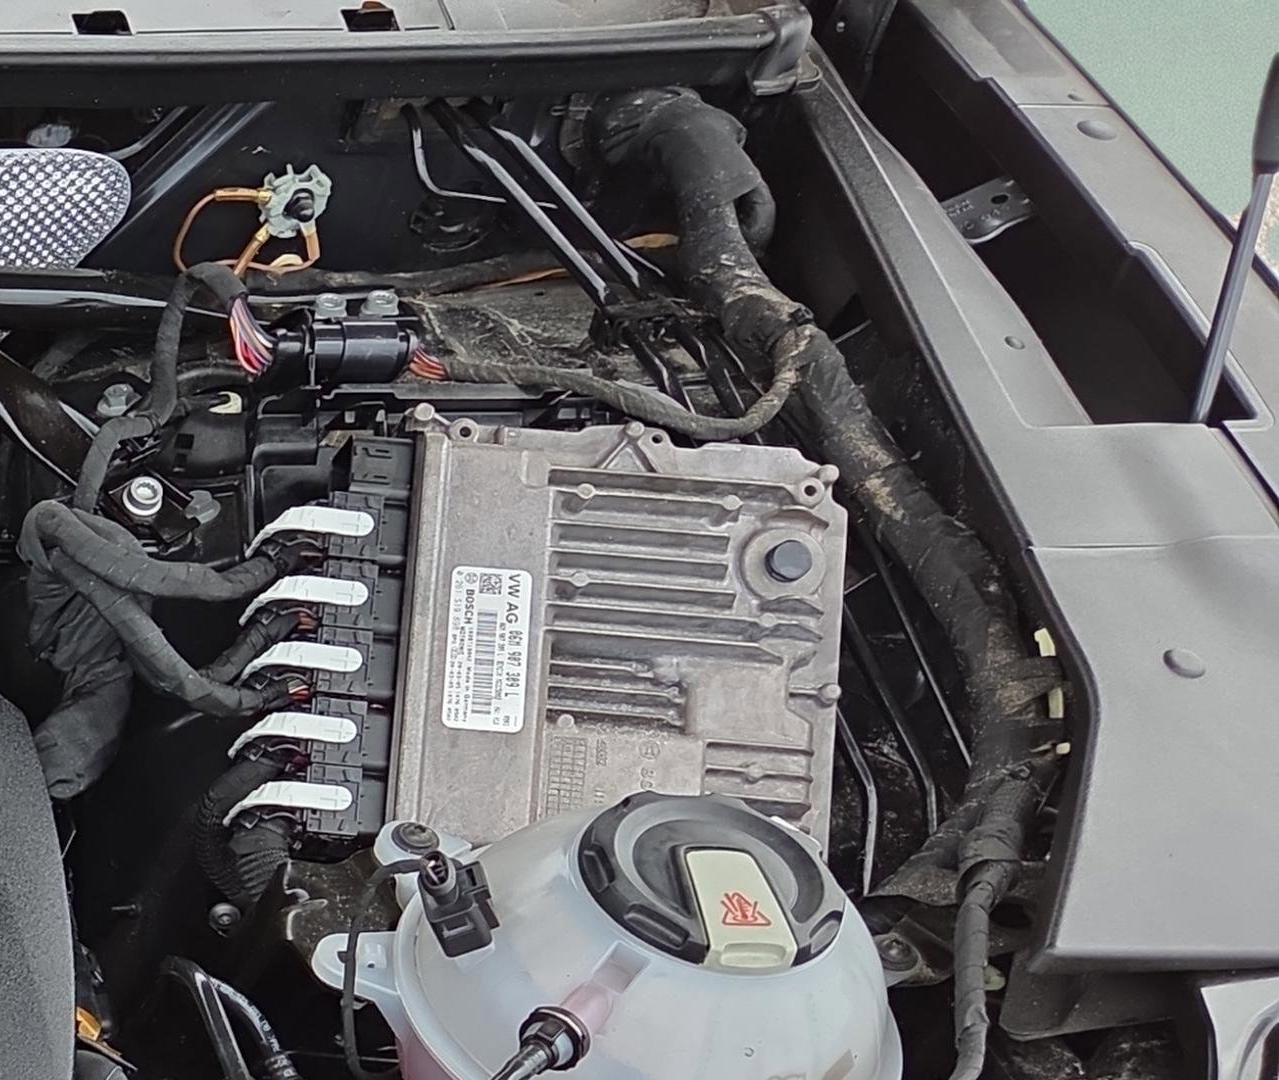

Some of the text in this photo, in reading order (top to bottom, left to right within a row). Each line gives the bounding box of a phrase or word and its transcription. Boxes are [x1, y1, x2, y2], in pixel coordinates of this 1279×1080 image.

[507, 573, 522, 599] VW
[464, 589, 475, 625] BOSCH
[505, 601, 519, 625] AG
